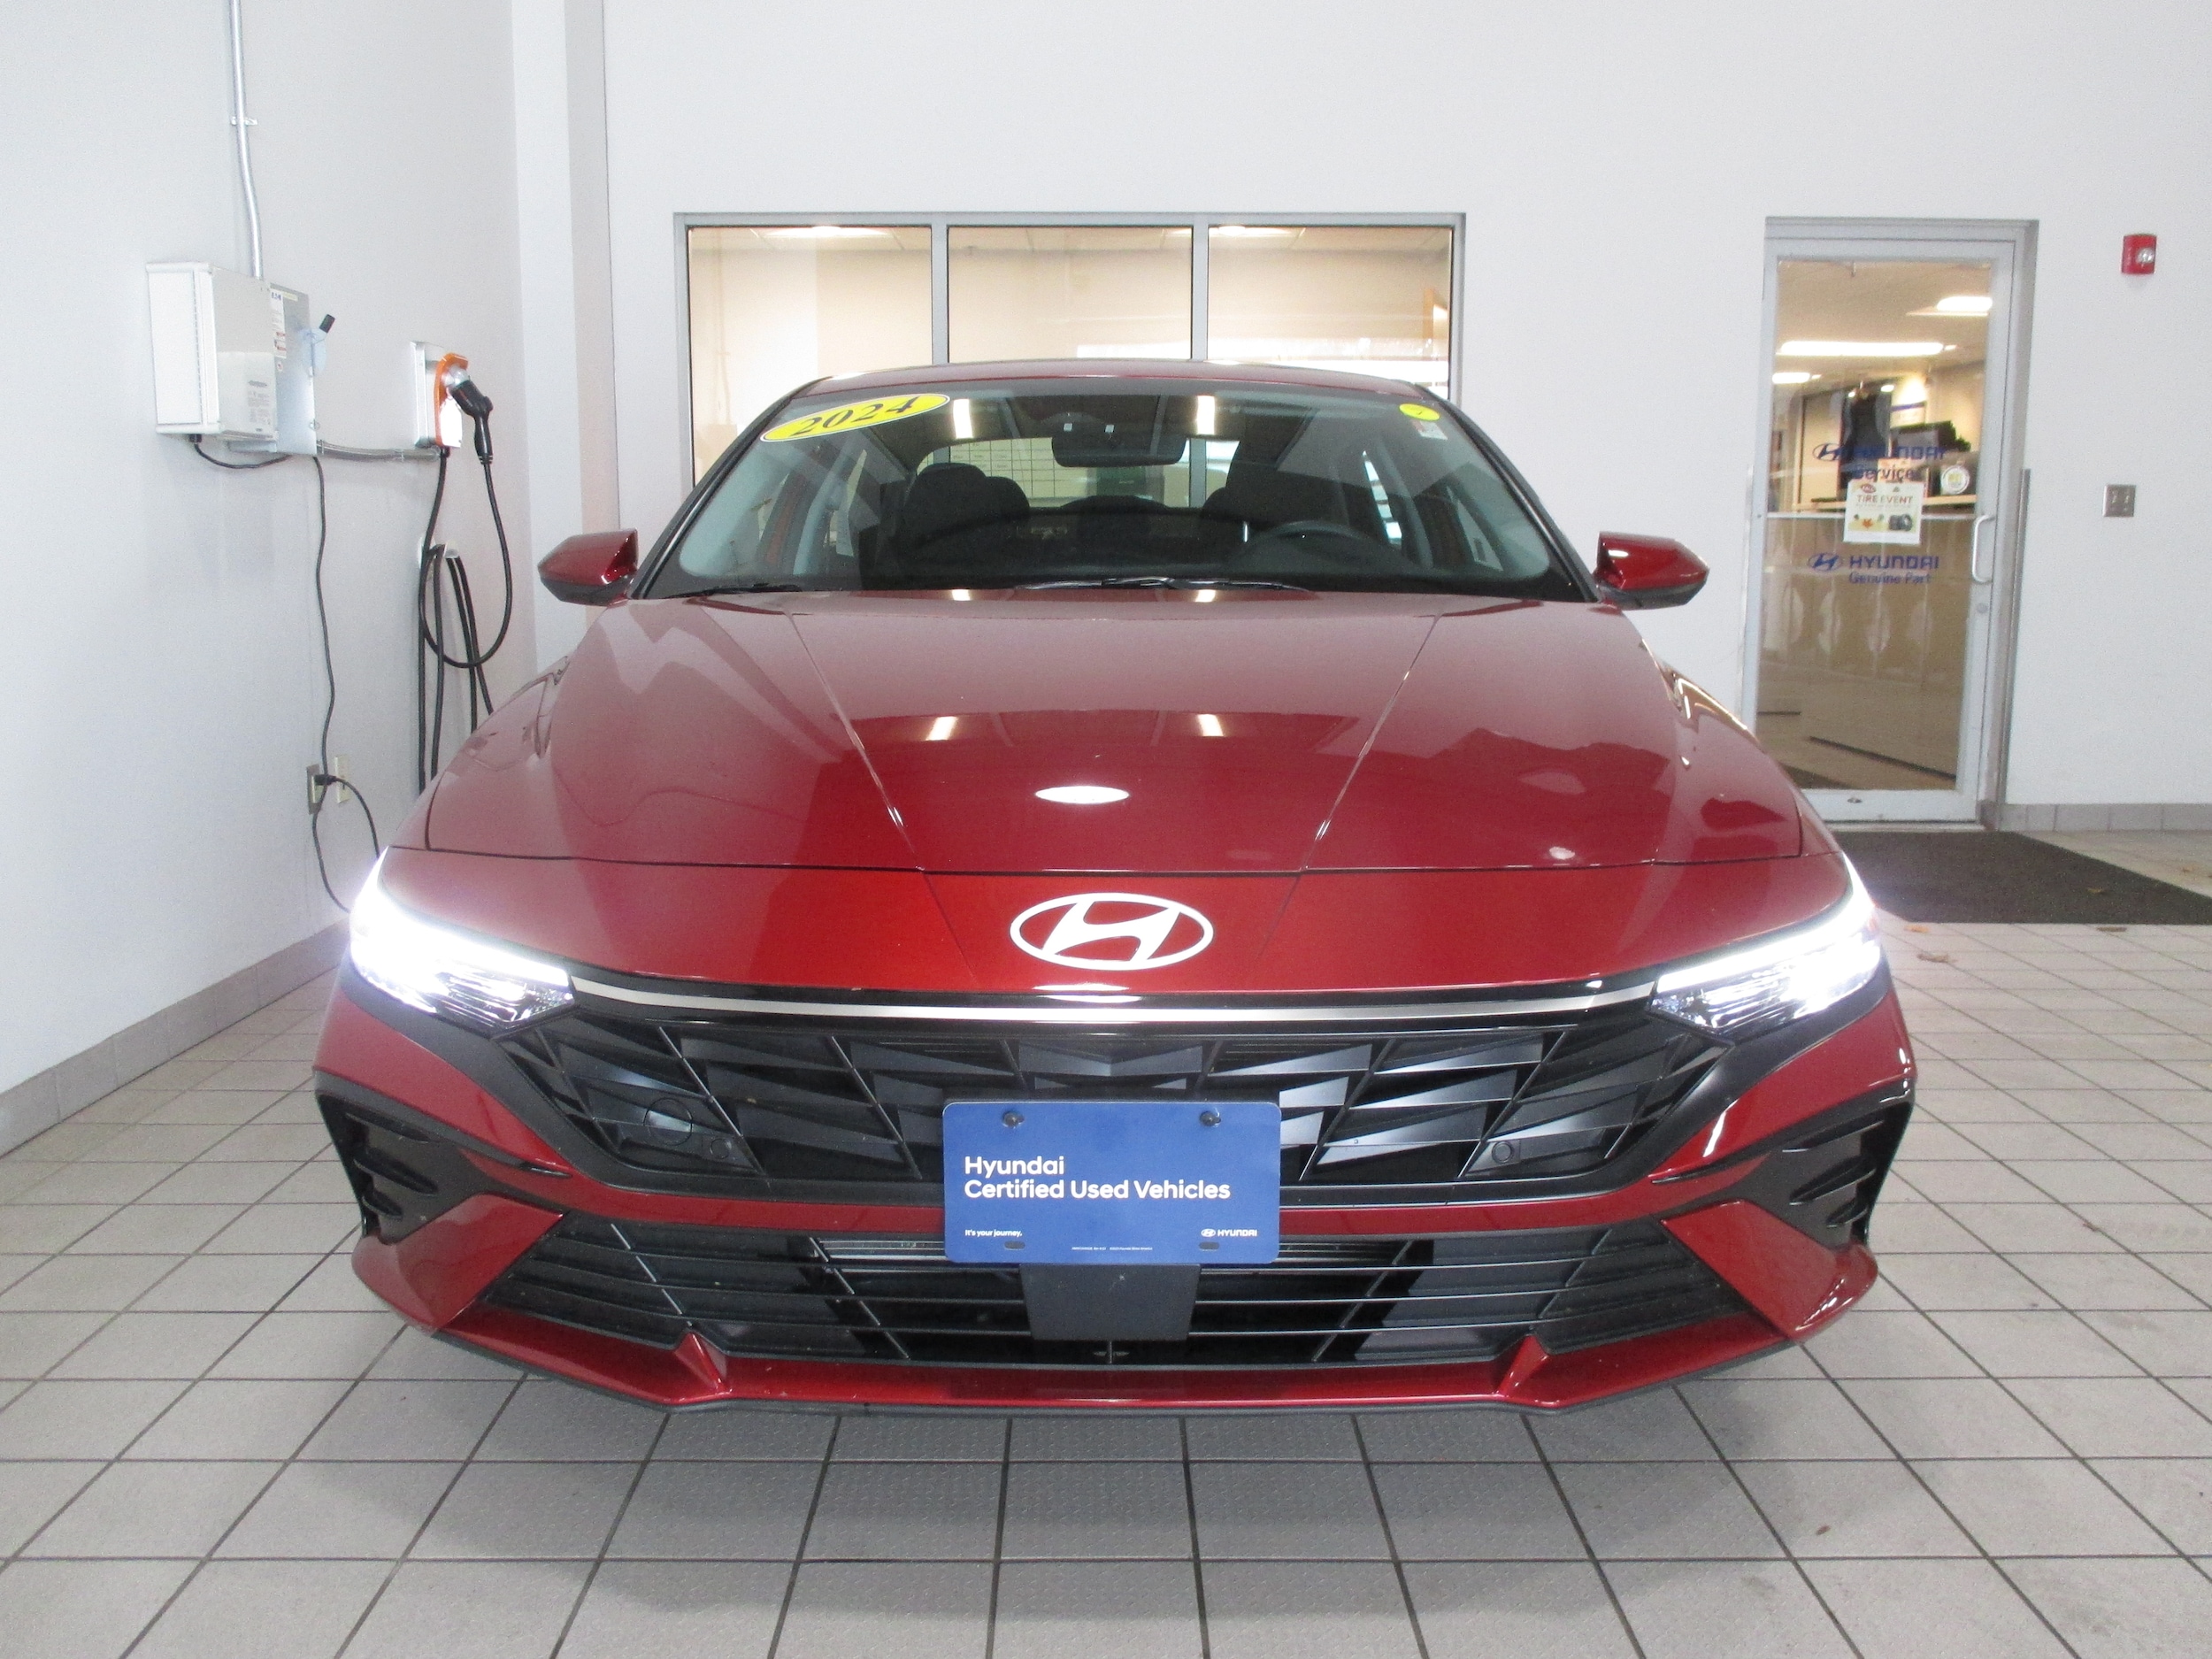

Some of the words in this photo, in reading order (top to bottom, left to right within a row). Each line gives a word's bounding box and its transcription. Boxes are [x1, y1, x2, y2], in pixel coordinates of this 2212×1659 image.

[790, 396, 920, 436] 2024
[1849, 556, 1939, 569] HYUNDAI
[964, 1156, 1064, 1179] Hyundai
[964, 1179, 1064, 1199] Certified
[1071, 1180, 1129, 1199] Used
[1133, 1179, 1231, 1199] Vehicles
